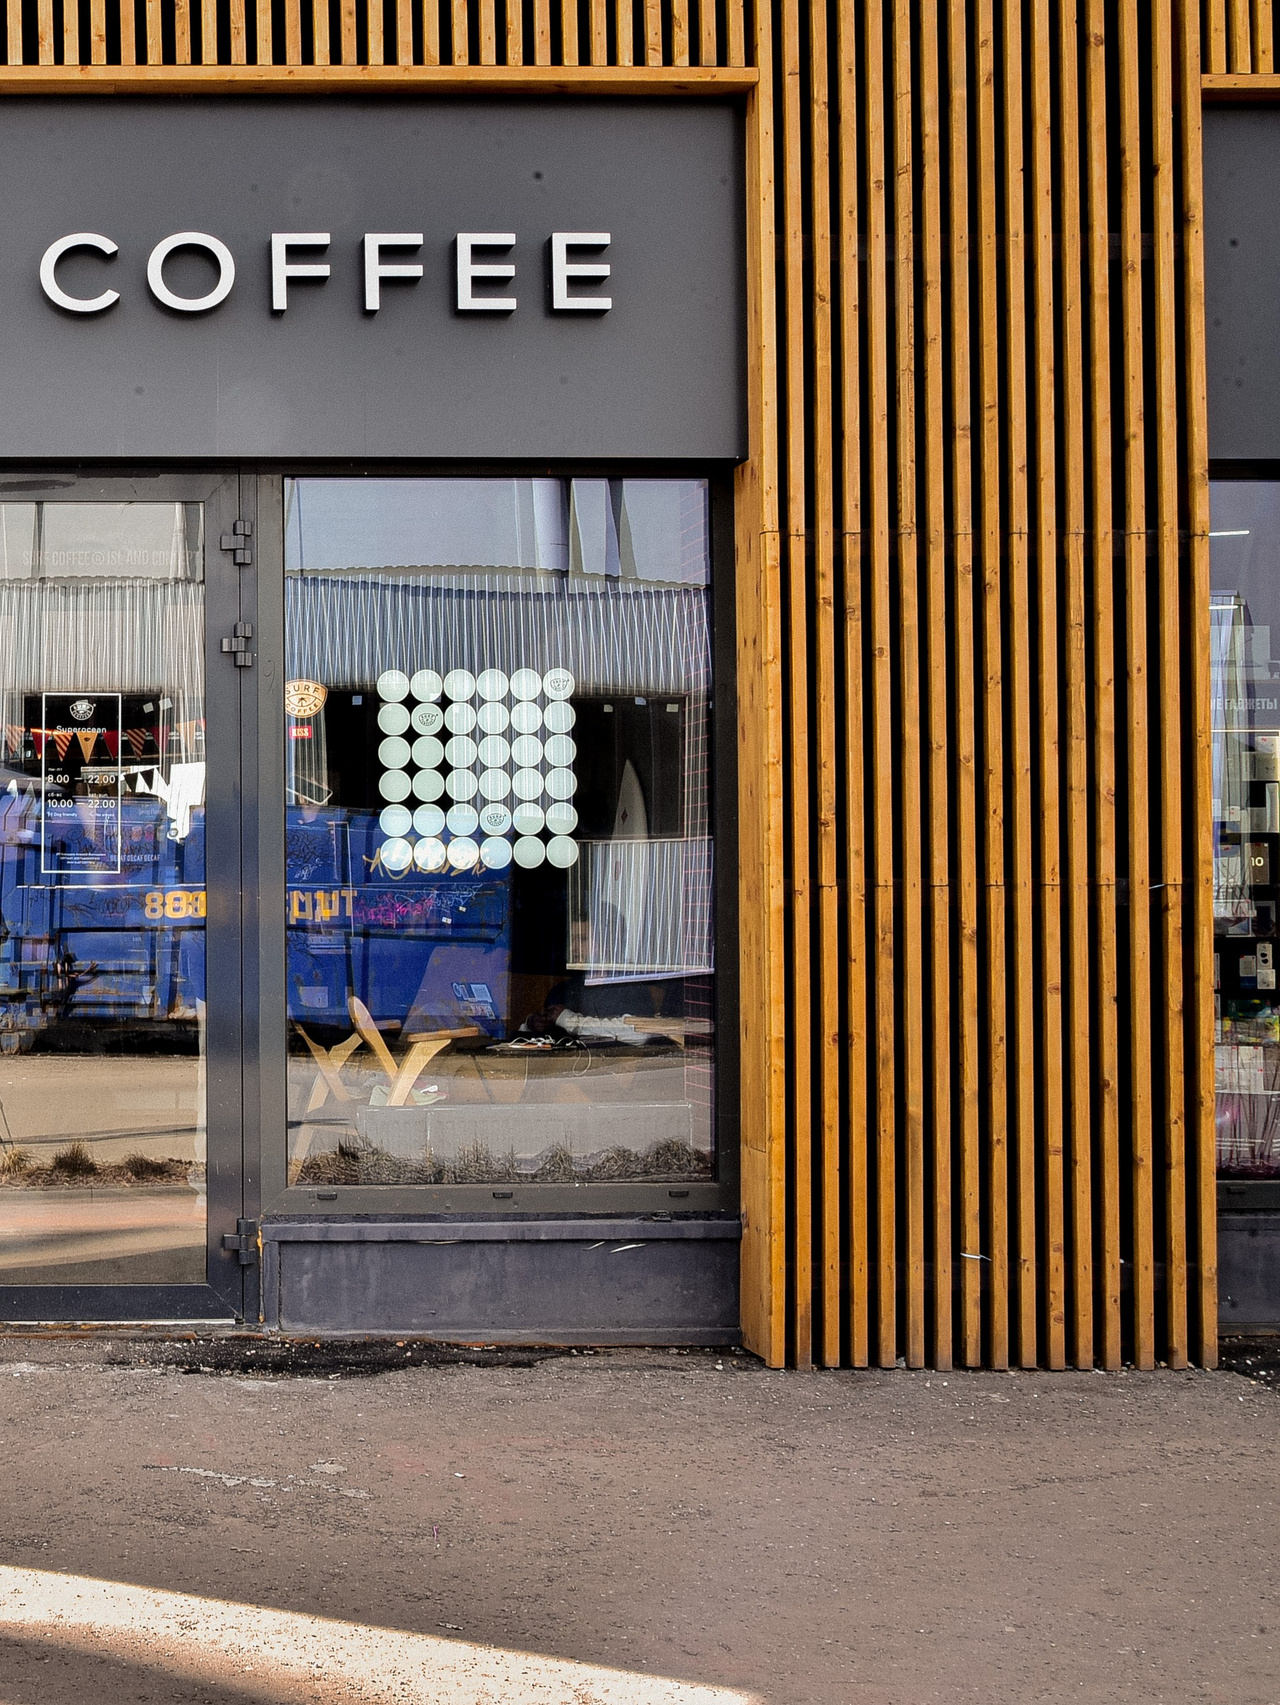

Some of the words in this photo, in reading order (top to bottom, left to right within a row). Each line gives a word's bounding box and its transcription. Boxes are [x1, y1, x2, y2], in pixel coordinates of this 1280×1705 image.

[39, 231, 613, 314] COFFEE
[56, 725, 107, 734] Superocean
[47, 774, 70, 784] 8.00
[87, 774, 116, 784] 22.00
[47, 799, 73, 808] 10.00
[87, 799, 116, 808] 22.00
[1251, 856, 1264, 867] 10
